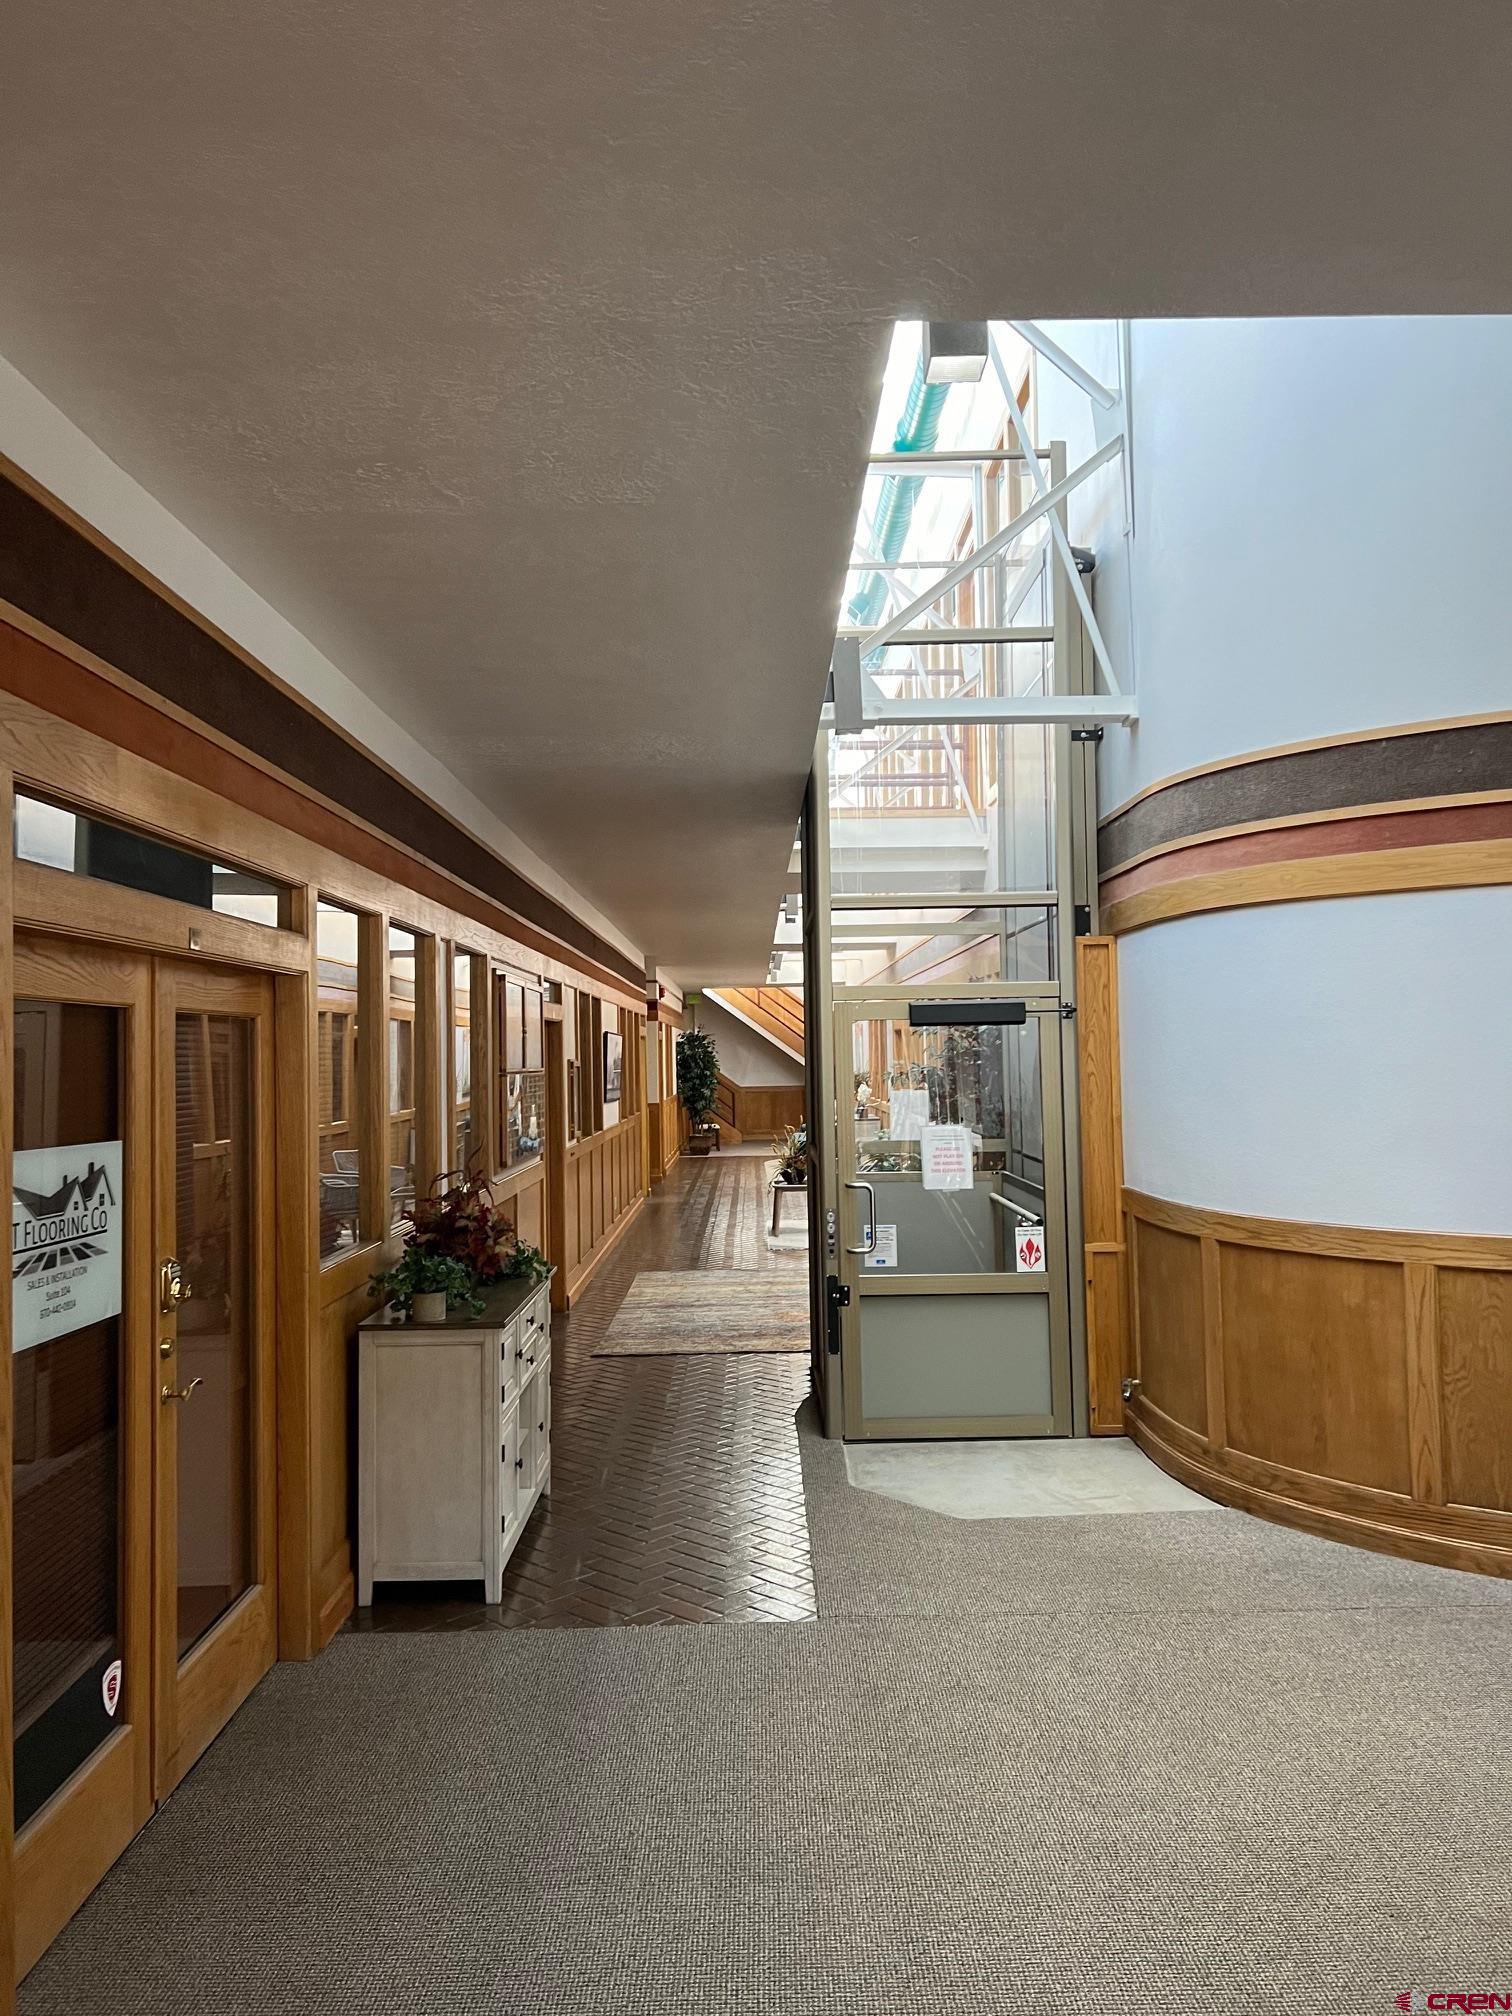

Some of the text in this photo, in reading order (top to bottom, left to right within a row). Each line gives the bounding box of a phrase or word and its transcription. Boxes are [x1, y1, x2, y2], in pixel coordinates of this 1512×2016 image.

[24, 1214, 88, 1247] FLOORING
[27, 1277, 45, 1291] SALES
[51, 1266, 88, 1284] INSTALLATION
